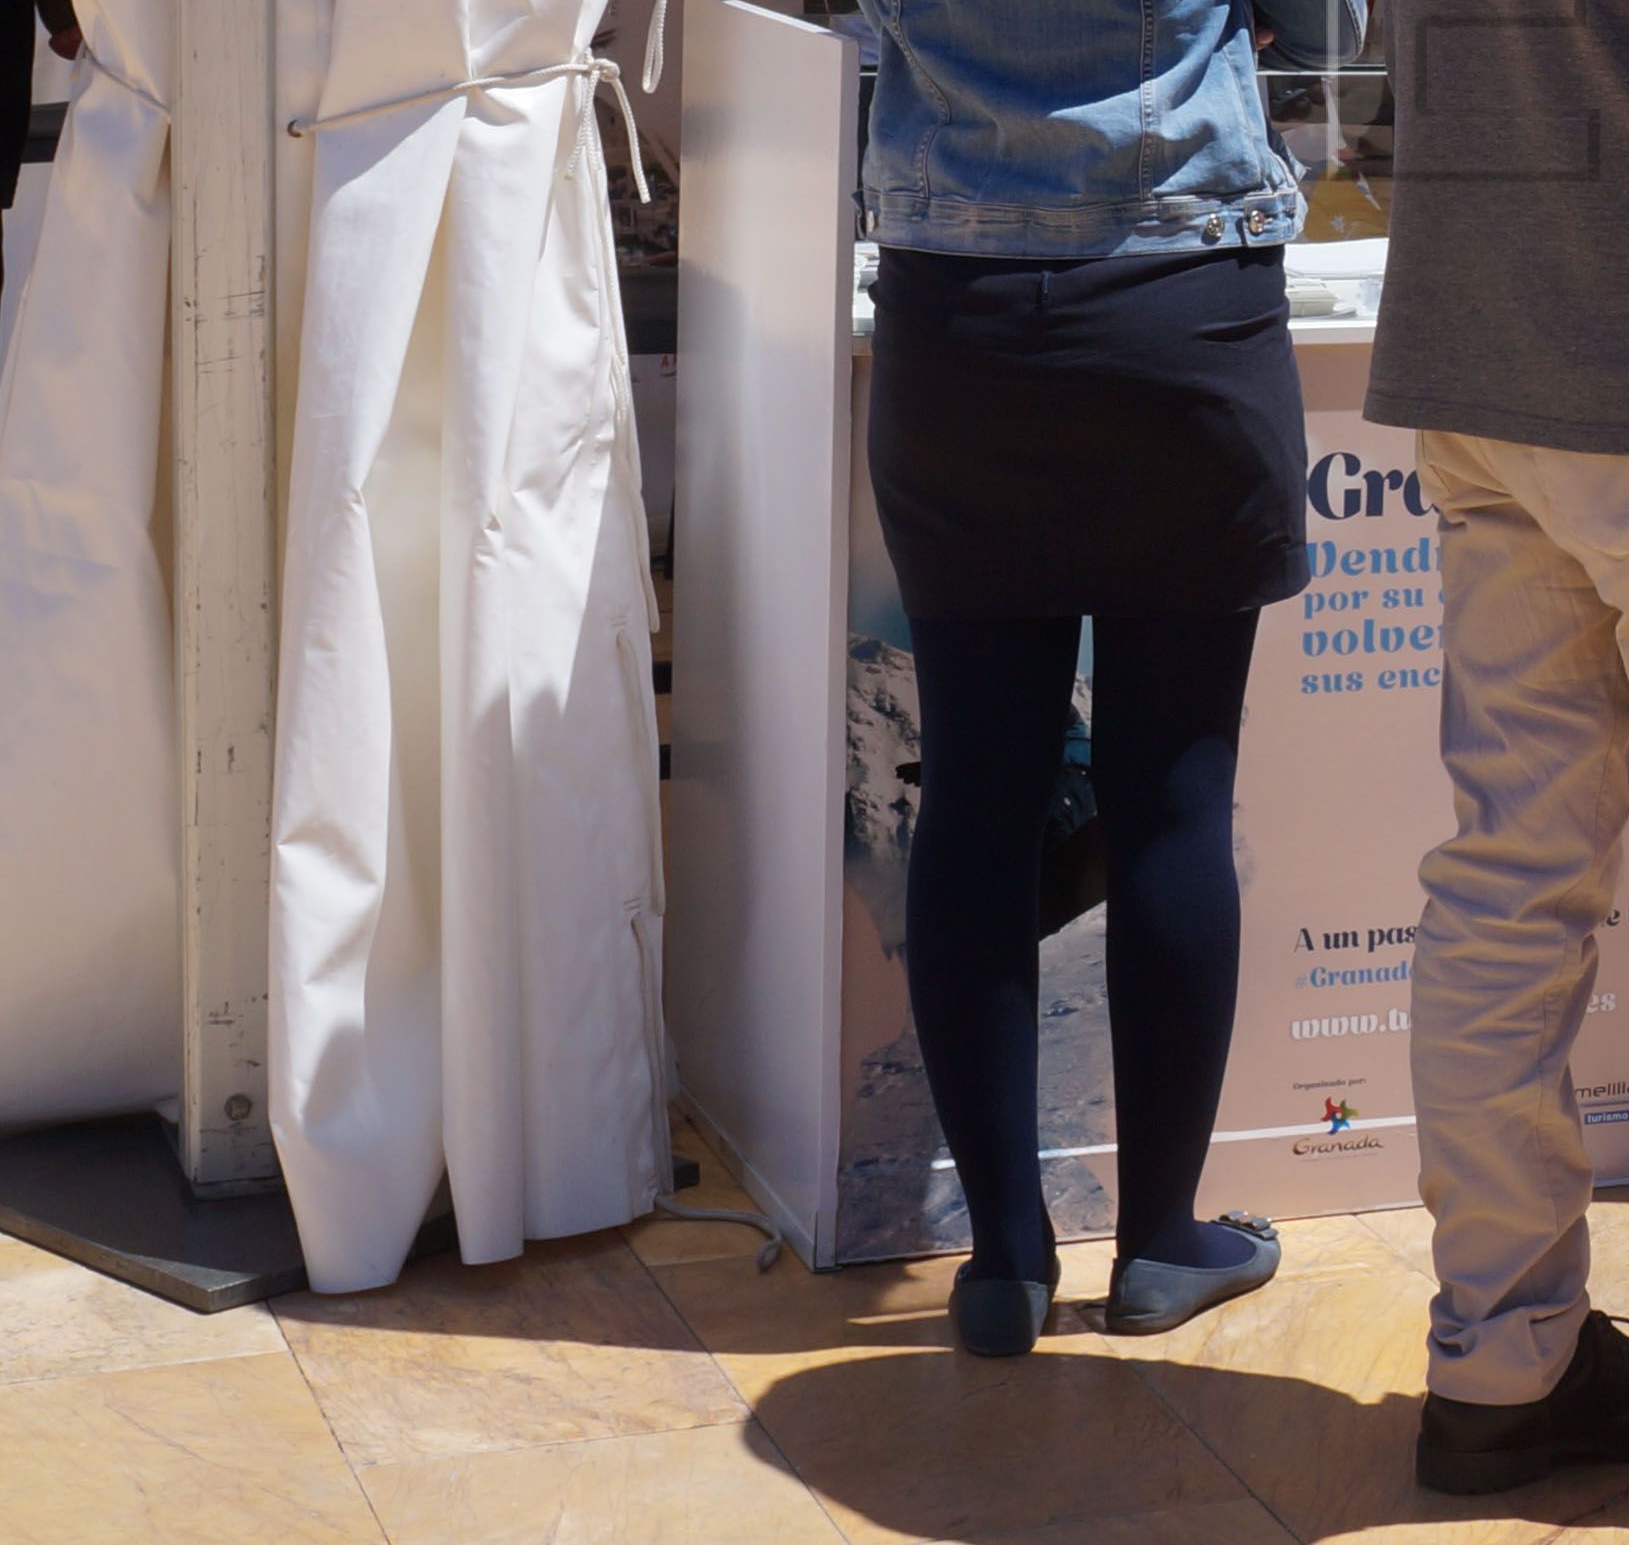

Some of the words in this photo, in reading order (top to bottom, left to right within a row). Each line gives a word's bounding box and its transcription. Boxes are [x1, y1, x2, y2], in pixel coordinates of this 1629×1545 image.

[1304, 589, 1369, 620] por
[1382, 588, 1424, 609] su
[1300, 672, 1364, 695] sus
[1294, 927, 1315, 953] A
[1322, 929, 1360, 950] un
[1601, 909, 1621, 927] e
[1586, 1112, 1629, 1123] turismo
[1292, 1134, 1384, 1156] Granada
